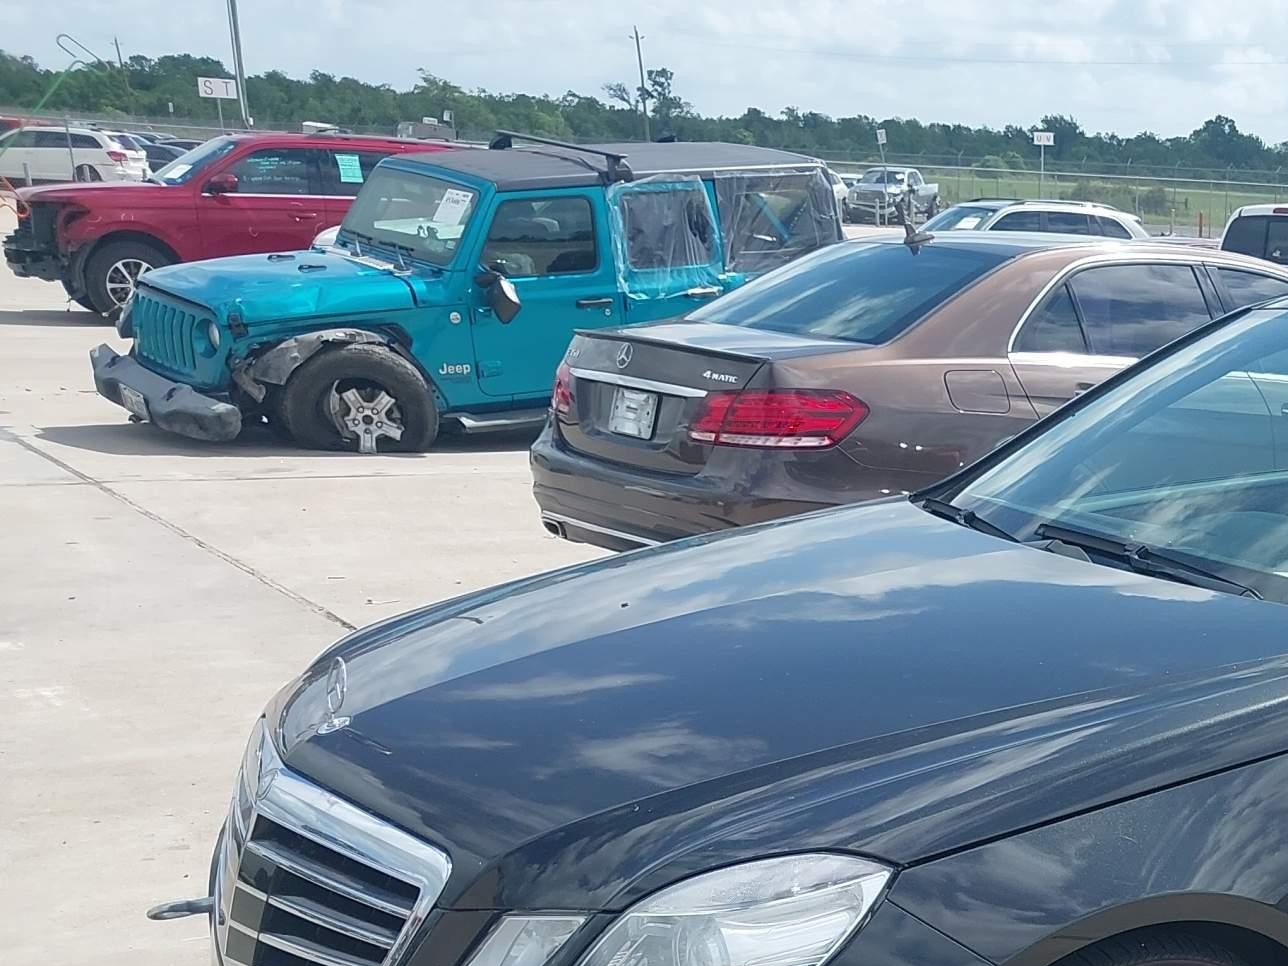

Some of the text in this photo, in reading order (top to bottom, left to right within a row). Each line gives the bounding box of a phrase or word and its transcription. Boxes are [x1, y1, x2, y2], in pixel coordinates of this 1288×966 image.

[203, 79, 232, 97] S T
[439, 362, 471, 375] Jeep
